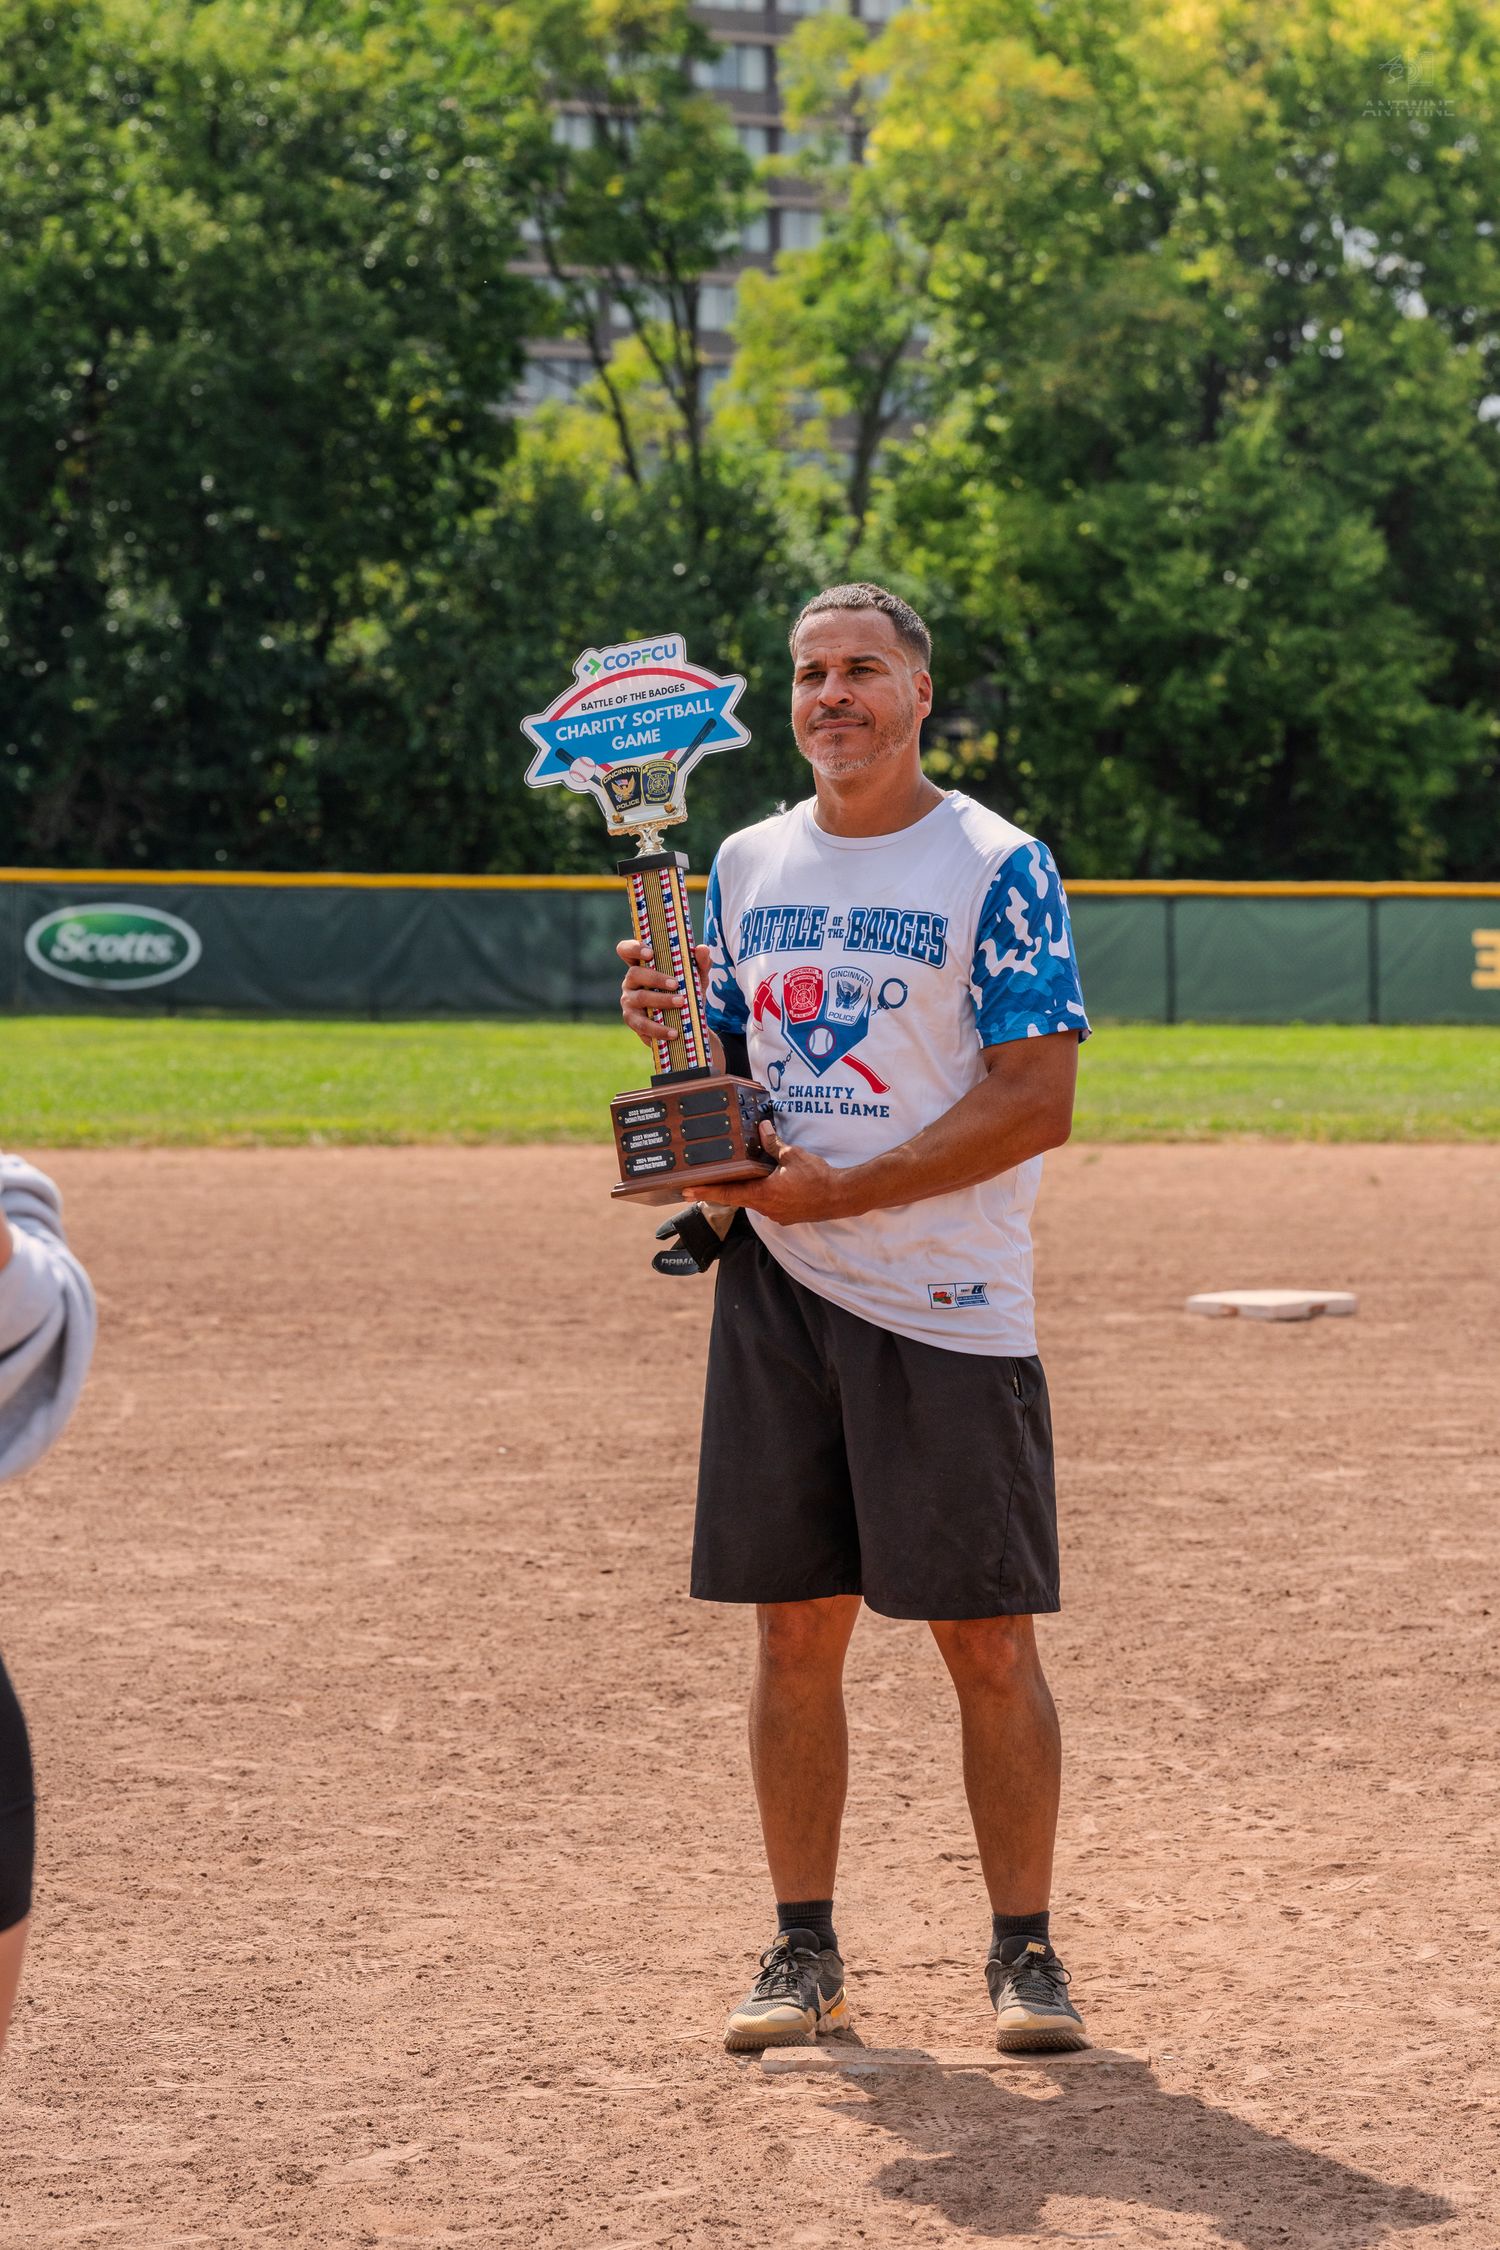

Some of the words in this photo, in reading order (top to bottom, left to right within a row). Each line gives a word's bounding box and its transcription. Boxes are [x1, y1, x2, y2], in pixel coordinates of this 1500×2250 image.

[603, 643, 677, 671] COPFCU
[581, 698, 613, 711] BATTLE
[615, 695, 628, 704] OF
[630, 691, 647, 702] THE
[648, 683, 686, 698] BADGES
[555, 714, 628, 742] CHARITY
[632, 698, 714, 728] SOFTBALL
[611, 728, 661, 751] GAME
[603, 767, 640, 784] CINCINNATI
[616, 798, 640, 811] POLICE
[832, 916, 843, 927] OF
[737, 905, 830, 966] BATTLE
[827, 928, 845, 939] THE
[844, 907, 949, 969] BADGES
[51, 922, 175, 964] Scotts
[830, 970, 871, 987] CINCINNATI
[828, 1011, 856, 1022] POLICE
[788, 1085, 855, 1100] CHARITY
[772, 1100, 834, 1114] OFTBALL
[840, 1102, 890, 1118] GAME
